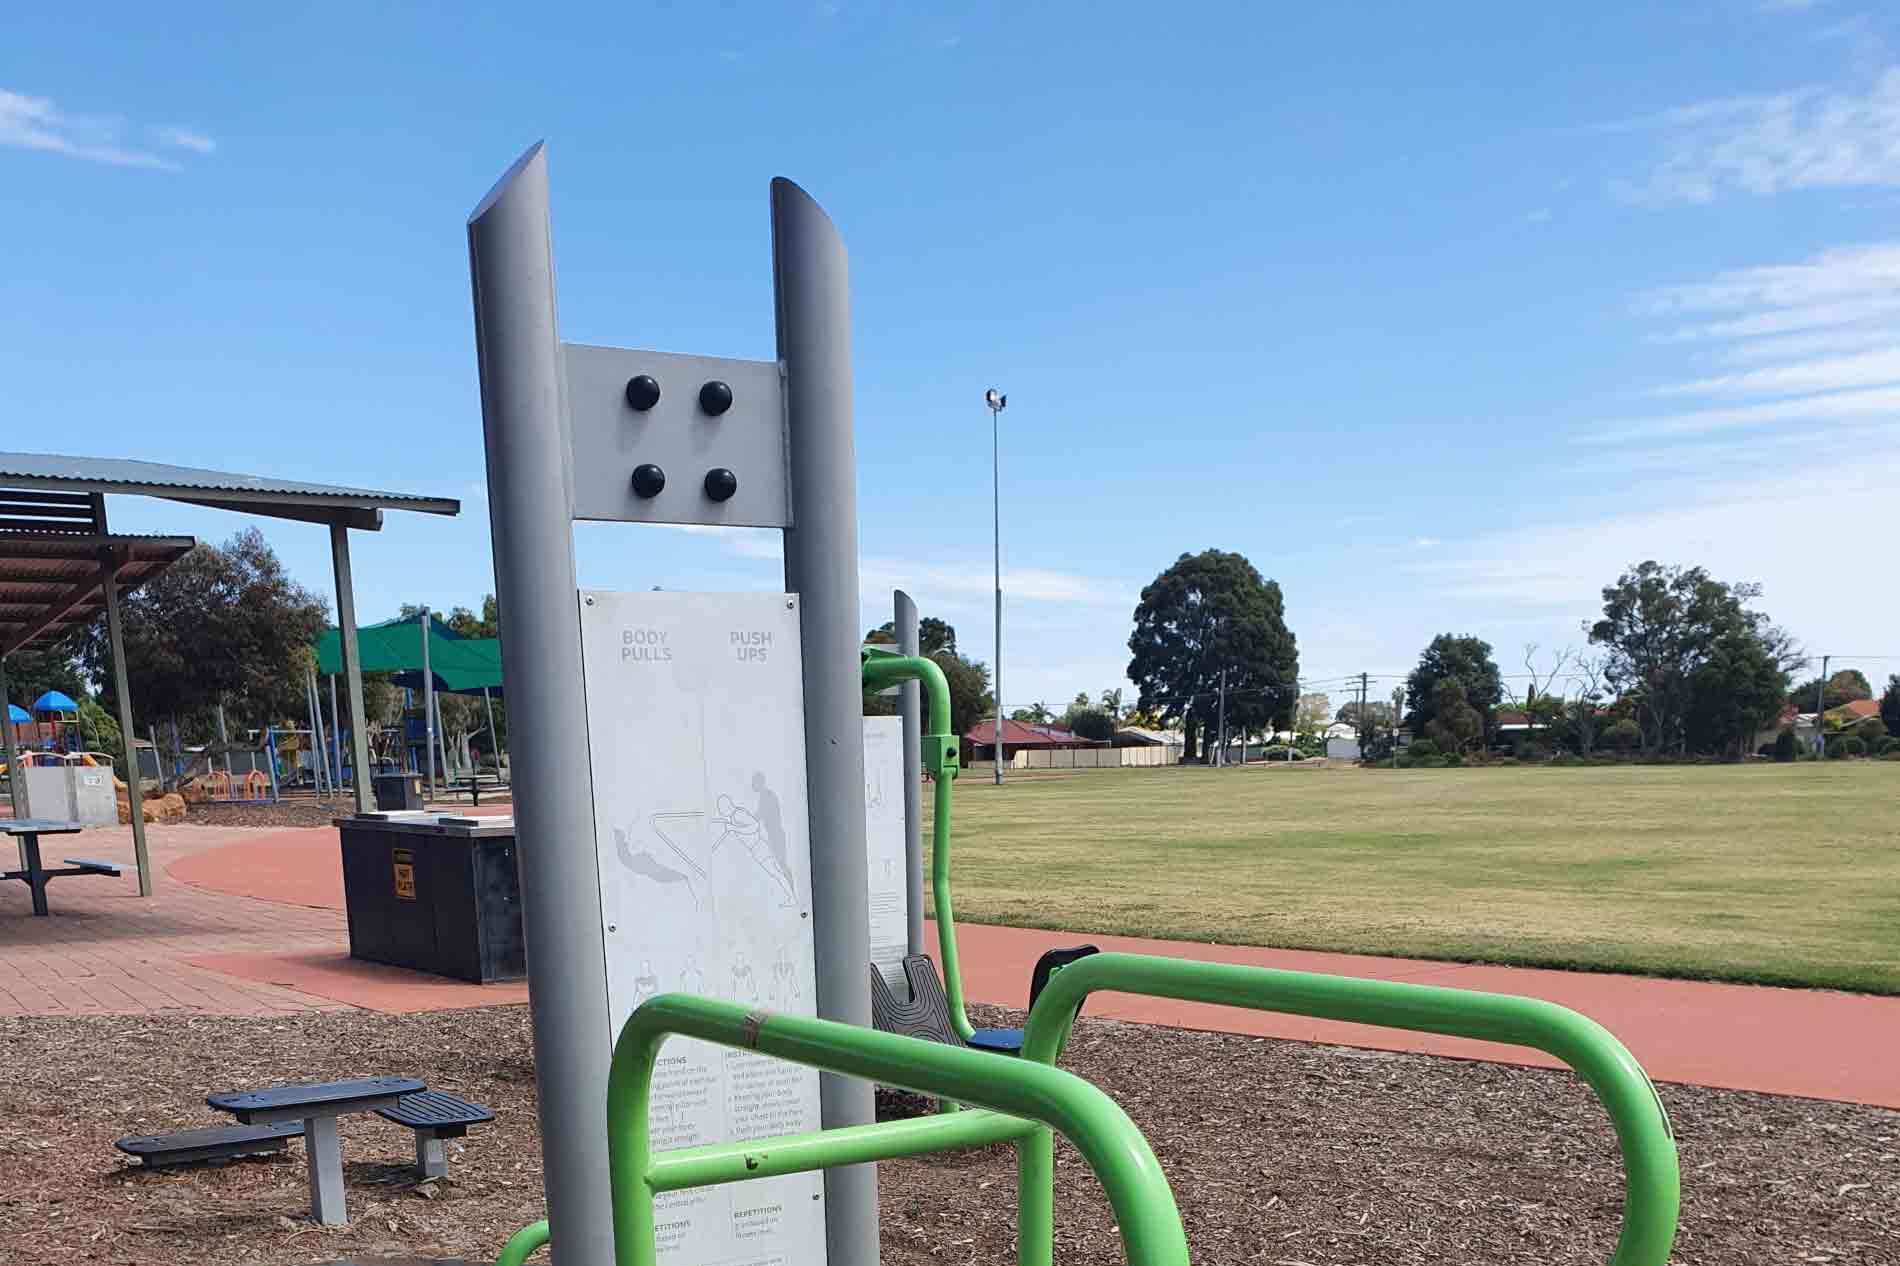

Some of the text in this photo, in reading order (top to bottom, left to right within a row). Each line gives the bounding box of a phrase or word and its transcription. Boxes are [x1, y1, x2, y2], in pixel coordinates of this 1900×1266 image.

[622, 629, 667, 645] BODY
[729, 631, 772, 646] PUSH
[621, 647, 673, 662] PULLS
[736, 647, 768, 662] UPS
[656, 1056, 687, 1066] CTIONS
[734, 1205, 782, 1219] REPETITIONS
[655, 1219, 691, 1232] ETITIONS
